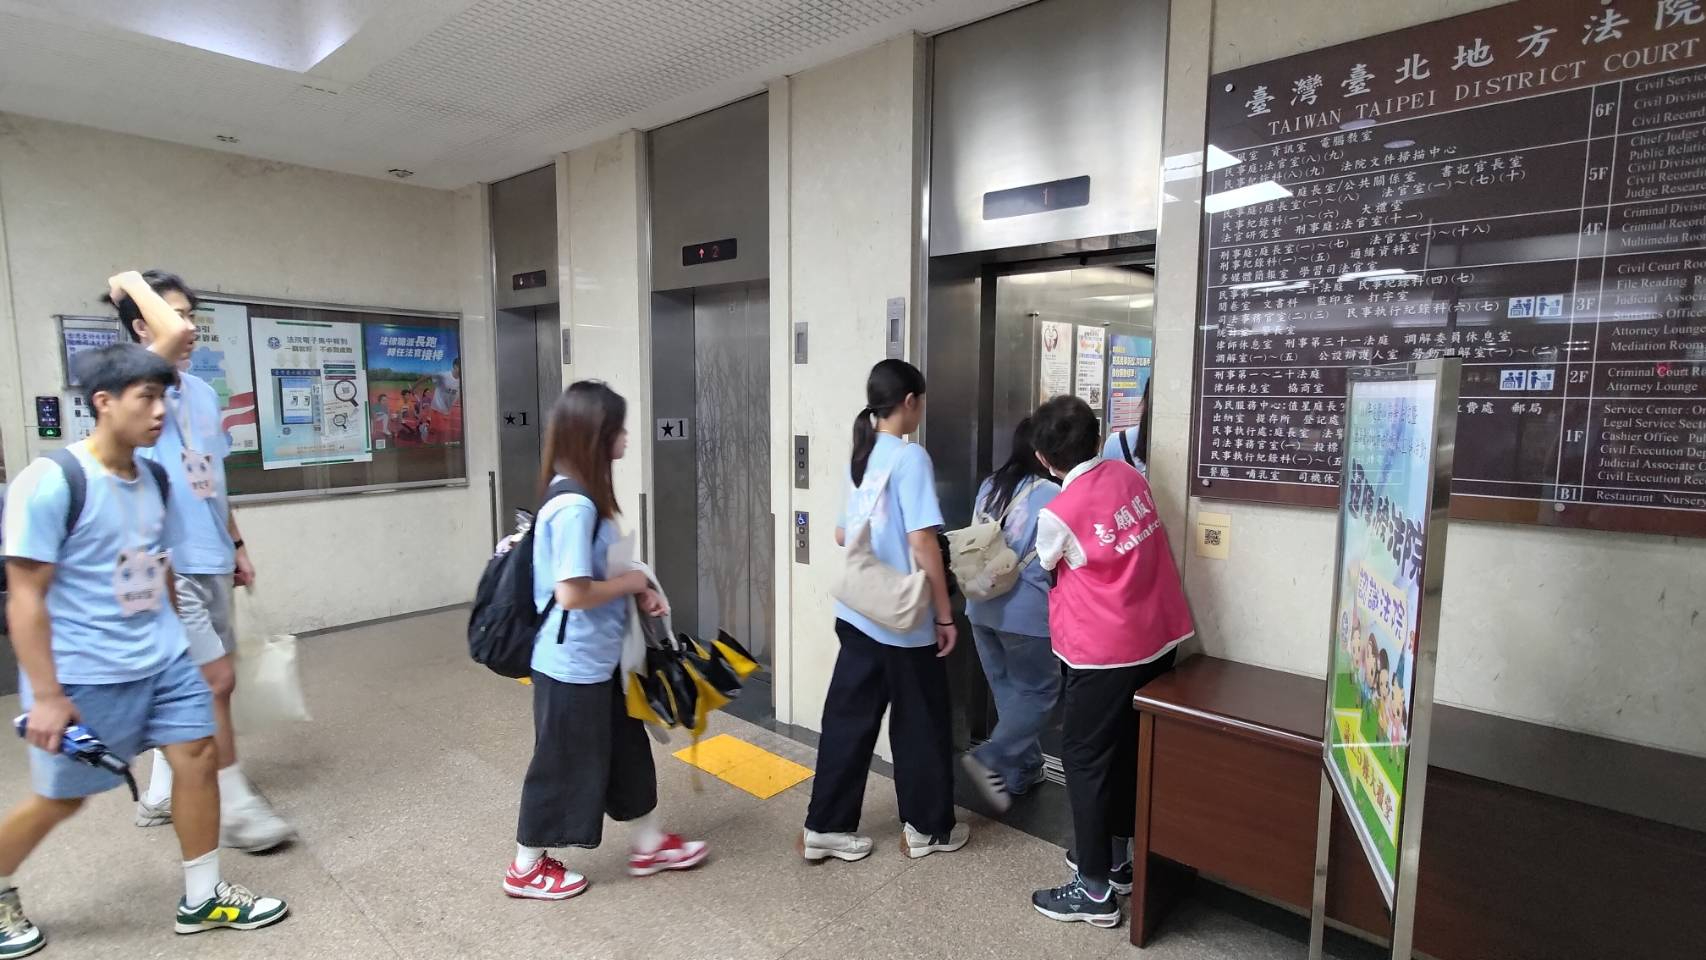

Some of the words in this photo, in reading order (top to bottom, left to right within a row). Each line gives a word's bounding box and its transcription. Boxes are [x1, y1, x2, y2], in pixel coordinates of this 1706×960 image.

[1244, 0, 1706, 118] 臺灣臺北地方法院
[1268, 108, 1343, 137] TAIWAN
[1355, 89, 1438, 119] TAIPEI
[1455, 60, 1587, 101] DISTRICT
[1604, 37, 1701, 72] COURT
[1635, 76, 1664, 92] Civil
[1633, 95, 1662, 110] Civil
[1595, 102, 1615, 118] 6F
[1632, 112, 1660, 127] Civil
[1319, 130, 1373, 149] 電腦教室
[1630, 132, 1664, 147] Chief
[1664, 128, 1699, 143] Judge
[1341, 145, 1457, 172] 法院文件掃描中心
[1629, 147, 1665, 160] Public
[1440, 155, 1524, 178] 書記官長室
[1588, 166, 1609, 181] 5F
[1627, 160, 1656, 174] Civil
[1626, 174, 1655, 186] Civil
[1624, 186, 1659, 199] Judge
[1361, 201, 1404, 215] 大禮堂
[1623, 203, 1668, 218] Criminal
[1583, 221, 1604, 237] 4F
[1621, 218, 1666, 233] Criminal
[1220, 228, 1283, 243] 法官研究室
[1620, 233, 1679, 248] Multimedia
[1219, 268, 1290, 285] 多媒體簡報室
[1299, 261, 1379, 278] 學習司法官室
[1617, 262, 1646, 275] Civil
[1648, 260, 1681, 272] Court
[1616, 279, 1639, 290] File
[1640, 275, 1688, 289] Reading
[1263, 297, 1299, 310] 文書科
[1317, 294, 1355, 306] 監印室
[1368, 290, 1409, 304] 打字室
[1575, 297, 1596, 311] 3F
[1615, 292, 1658, 306] Judicial
[1666, 307, 1703, 319] Office
[1611, 325, 1660, 337] Attorney
[1216, 339, 1273, 350] 律師休息室
[1284, 334, 1390, 349] 刑事第三十一法庭
[1404, 330, 1513, 346] 調解委員休息室
[1610, 341, 1666, 352] Mediation
[1318, 349, 1399, 362] 公設辯護人室
[1569, 370, 1589, 384] 2F
[1607, 367, 1655, 378] Criminal
[1657, 365, 1689, 377] Court
[1214, 383, 1271, 394] 律師休息室
[1288, 383, 1325, 394] 協商室
[1606, 382, 1654, 393] Attorney
[1656, 381, 1699, 394] Lounge
[1511, 401, 1543, 415] 郵局
[1604, 403, 1643, 415] Service
[1646, 404, 1683, 415] Center
[519, 411, 530, 426] 1
[1212, 413, 1246, 425] 出納室
[1256, 413, 1291, 425] 提存所
[1303, 414, 1340, 426] 登記處
[1603, 418, 1632, 429] Legal
[1635, 418, 1676, 429] Service
[676, 419, 686, 437] 1
[1566, 429, 1584, 443] 1F
[1601, 431, 1641, 442] Cashier
[1643, 431, 1679, 442] Office
[1600, 444, 1626, 455] Civil
[1629, 445, 1684, 456] Execution
[1598, 457, 1640, 469] Judicial
[1642, 459, 1696, 471] Associate
[1209, 466, 1231, 478] 餐廳
[1245, 468, 1281, 481] 哺乳室
[1597, 470, 1624, 481] Civil
[1626, 471, 1681, 483] Execution
[1561, 487, 1577, 501] B1
[1596, 490, 1654, 503] Restaurant
